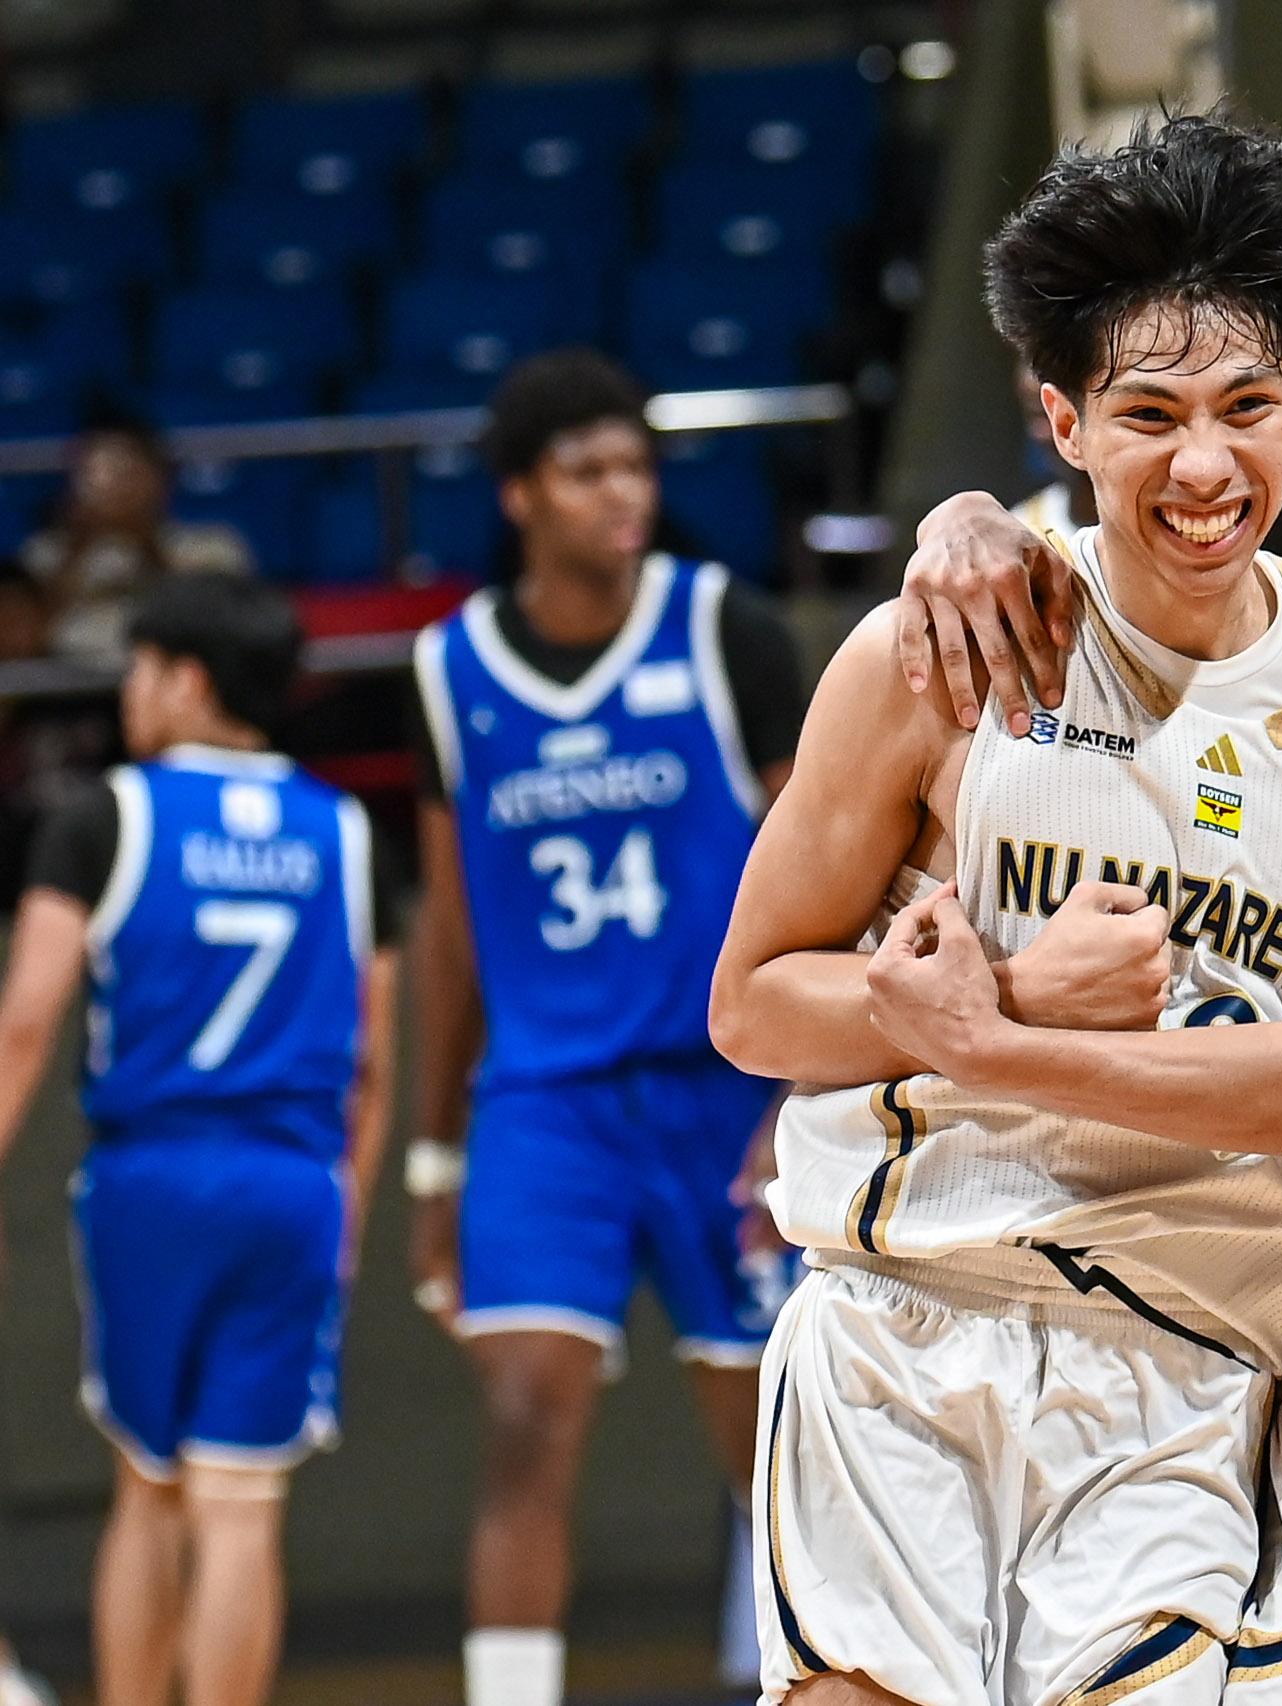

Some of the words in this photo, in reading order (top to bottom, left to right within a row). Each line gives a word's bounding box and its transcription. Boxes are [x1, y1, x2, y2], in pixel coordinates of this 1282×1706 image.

[1064, 723, 1135, 754] DATEM
[486, 749, 688, 828] ATENEO
[1200, 786, 1240, 807] BOYSEN
[529, 822, 669, 951] 34
[996, 837, 1085, 919] NU
[189, 899, 298, 1071] 7
